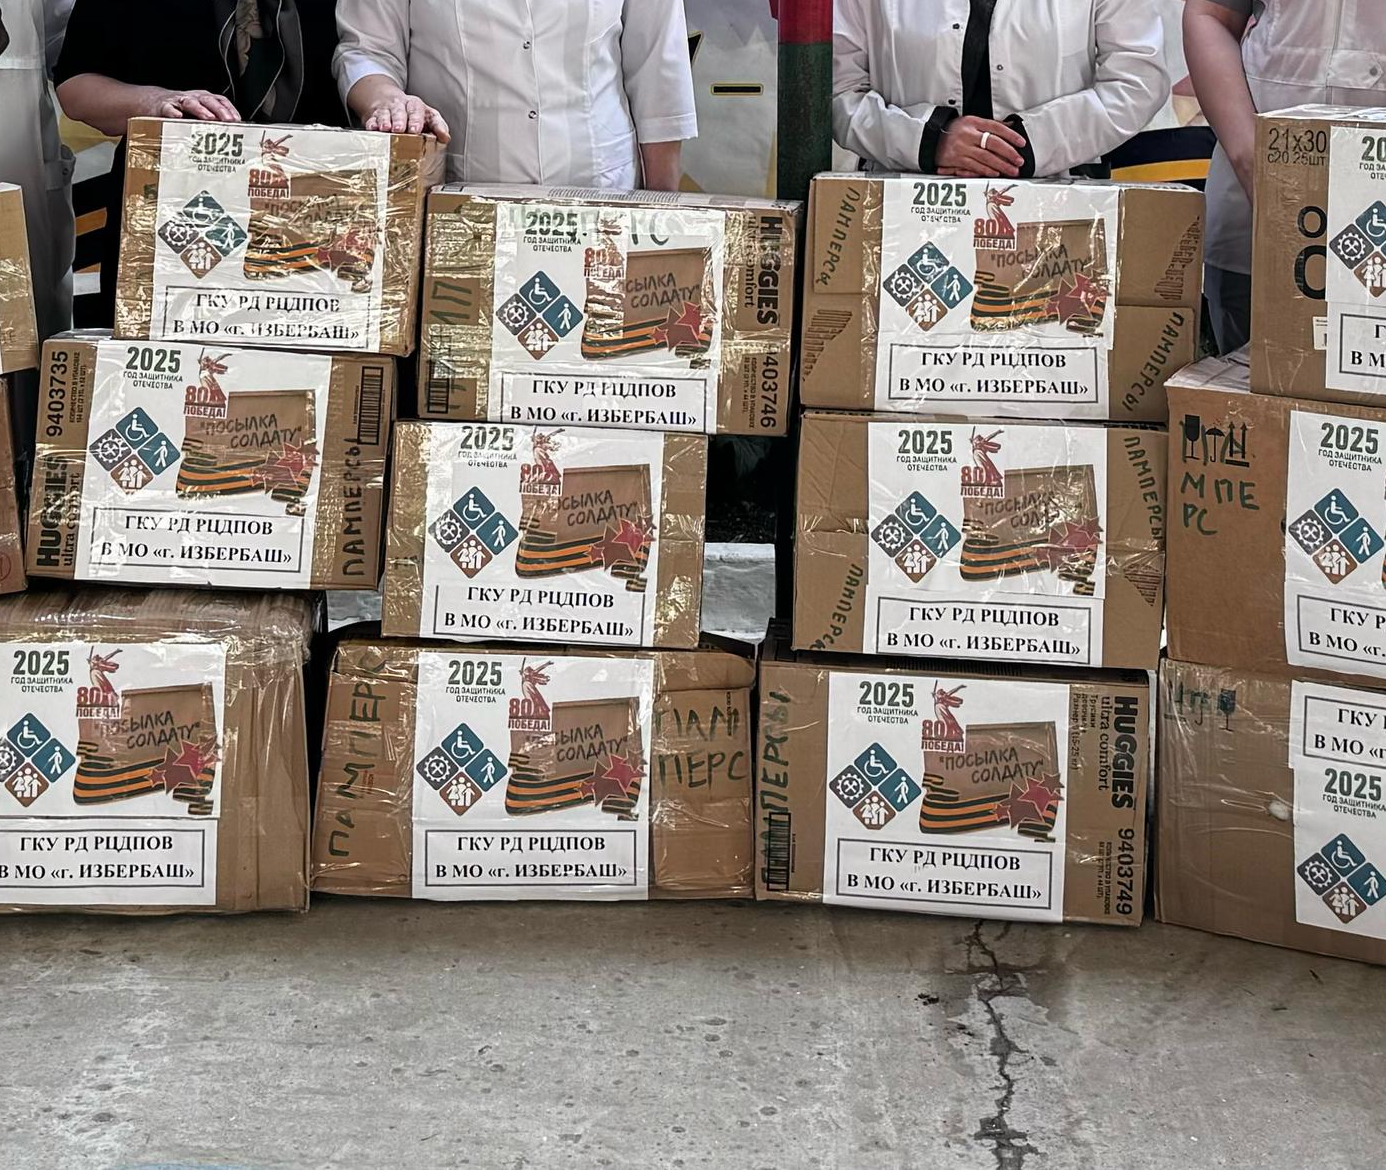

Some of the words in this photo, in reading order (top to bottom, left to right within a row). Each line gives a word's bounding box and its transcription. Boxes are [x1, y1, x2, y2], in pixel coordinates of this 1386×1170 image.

[922, 352, 958, 366] ГКУ
[963, 352, 986, 369] РД
[990, 353, 1067, 369] РЦДПОВ
[1351, 351, 1363, 365] В
[46, 350, 69, 438] 9403735
[760, 342, 779, 429] 403746
[101, 542, 113, 556] В
[118, 543, 149, 558] МО
[153, 548, 175, 559] «г.
[180, 545, 293, 563] ИЗБЕРБАШ»
[1331, 608, 1370, 627] ГКУ
[13, 650, 70, 676] 2025
[447, 660, 503, 687] 2025
[859, 681, 915, 708] 2025
[857, 706, 872, 715] ГОД
[873, 707, 919, 717] ЗАЩИТНИКА
[868, 715, 909, 725] ОТЕЧЕСТВА
[1099, 695, 1111, 730] ultra
[922, 720, 947, 739] 80
[1098, 733, 1109, 791] comfort
[1111, 696, 1138, 809] HUGGIES
[1323, 769, 1382, 802] 2025
[21, 837, 60, 852] ГКУ
[65, 836, 89, 853] РД
[94, 836, 174, 853] РЦДПОВ
[458, 837, 495, 851] ГКУ
[501, 836, 524, 853] РД
[529, 837, 606, 853] РЦДПОВ
[870, 847, 908, 863] ГКУ
[914, 850, 937, 868] РД
[942, 852, 1021, 871] РЦДПОВ
[1115, 828, 1135, 916] 9403749
[848, 874, 859, 887] В
[864, 875, 895, 891] МО
[900, 882, 922, 893] «г.
[928, 879, 1042, 899] ИЗБЕРБАШ»
